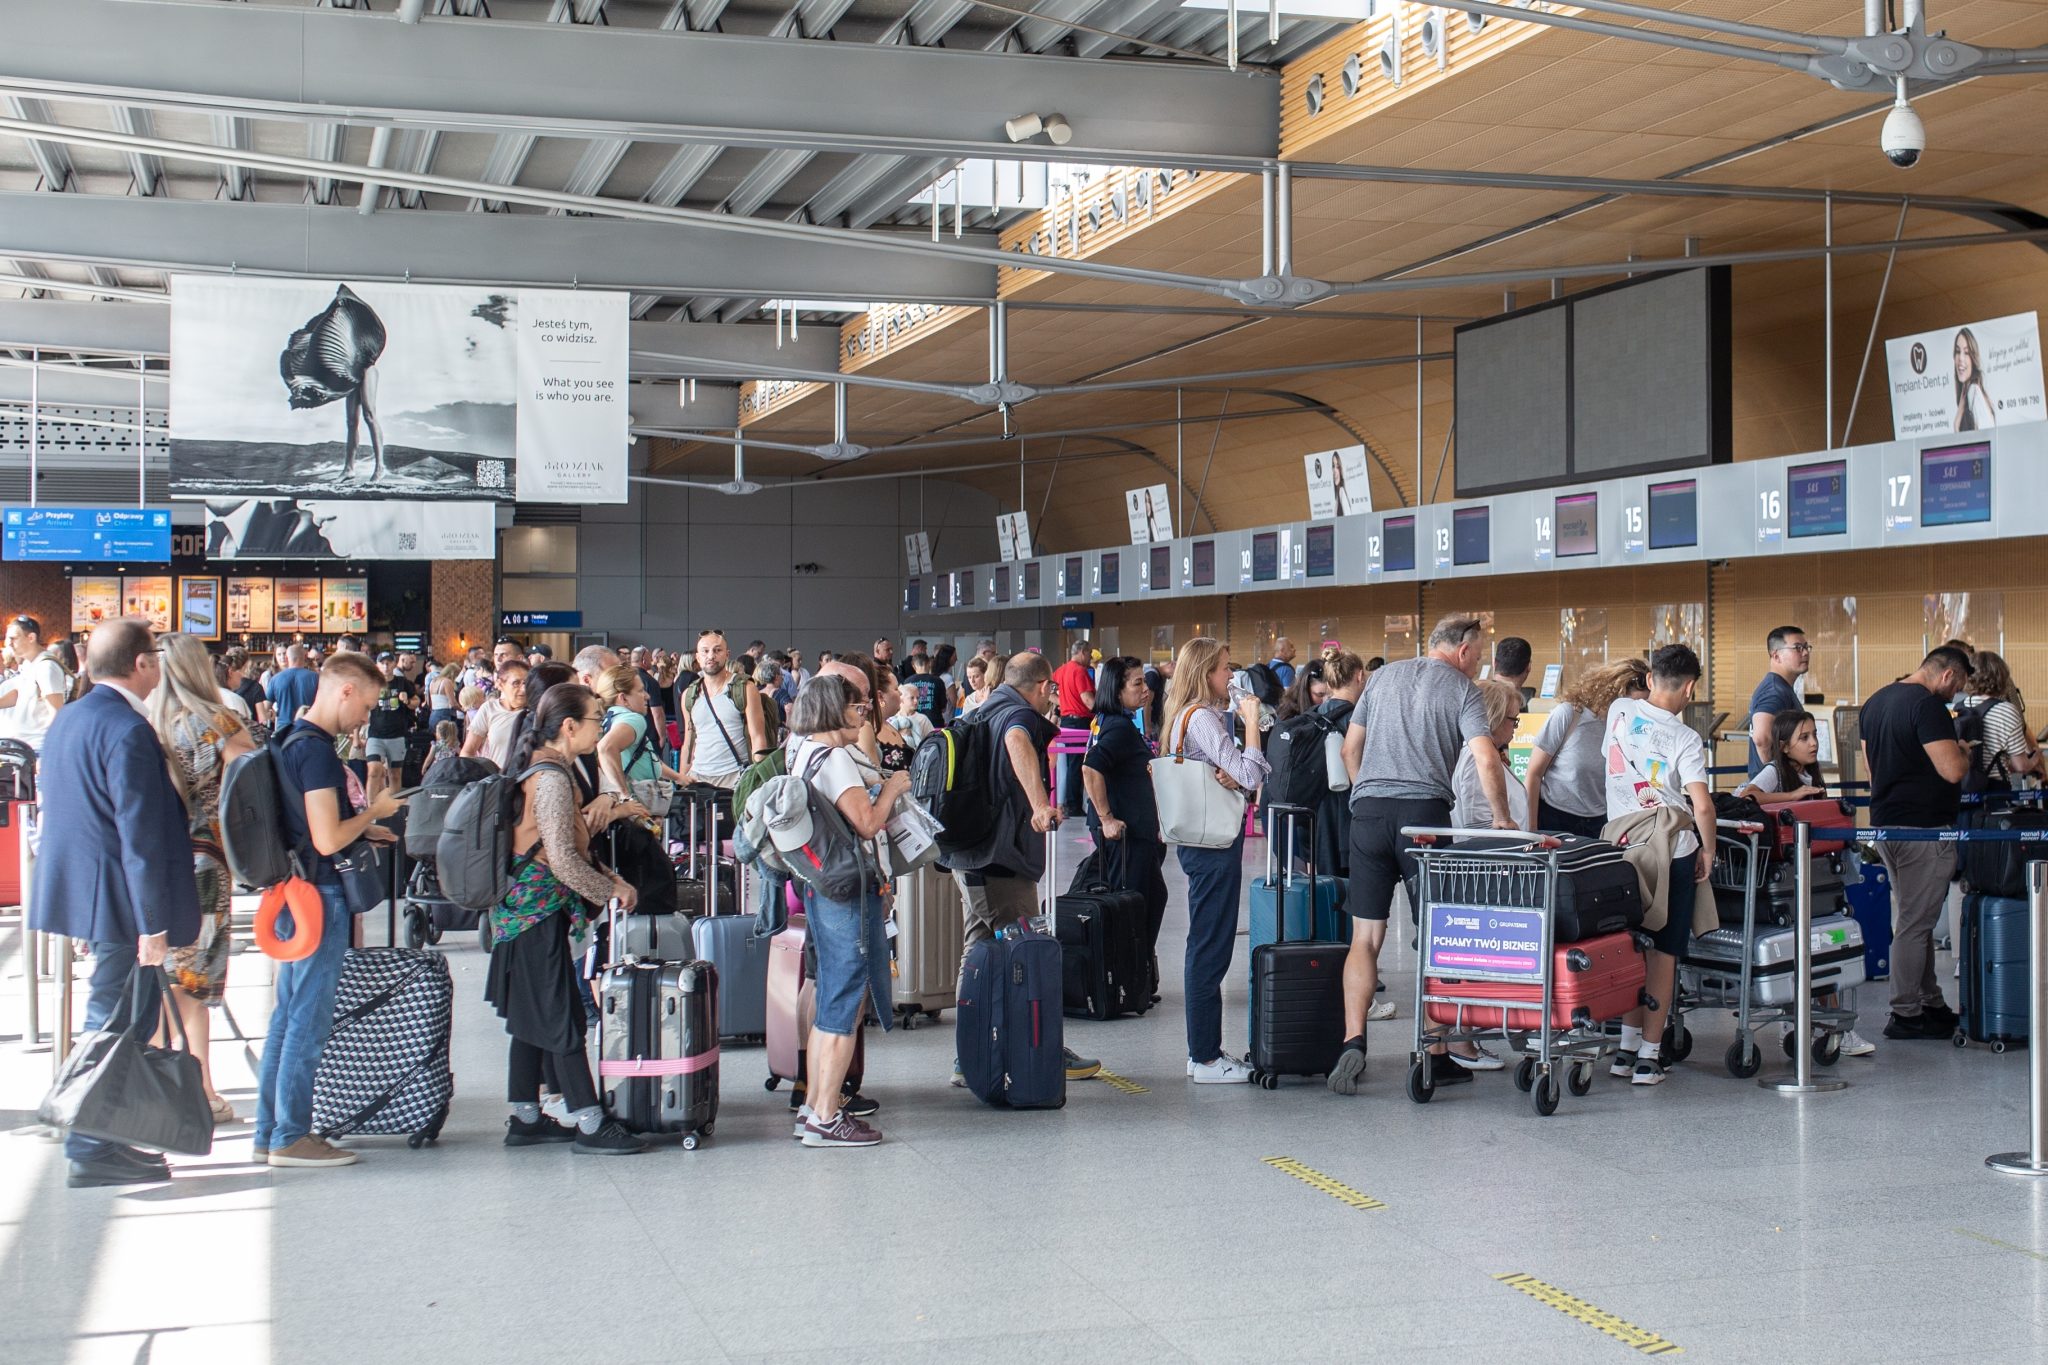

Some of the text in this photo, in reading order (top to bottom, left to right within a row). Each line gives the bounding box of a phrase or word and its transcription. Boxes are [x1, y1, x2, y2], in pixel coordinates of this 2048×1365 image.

[532, 319, 593, 331] Jesteś tym,
[541, 333, 597, 344] co widzisz.
[543, 377, 614, 389] What you see
[535, 391, 544, 400] is
[546, 391, 569, 401] who
[572, 394, 591, 403] you
[1942, 464, 1958, 479] SAS
[1888, 475, 1911, 507] 17
[1760, 490, 1780, 519] 16
[45, 512, 74, 520] Przyloty
[113, 512, 144, 521] Odprawy
[1625, 506, 1642, 533] 15
[1535, 517, 1550, 541] 14
[171, 534, 205, 556] COF
[1368, 536, 1380, 557] 12
[1436, 528, 1449, 551] 13
[1241, 550, 1251, 569] 10
[1293, 544, 1302, 563] 11
[1141, 562, 1147, 578] 8
[1183, 557, 1190, 575] 9
[1018, 575, 1023, 590] 5
[1058, 571, 1064, 586] 6
[1093, 567, 1099, 583] 7
[932, 586, 937, 599] 2
[956, 582, 961, 595] 3
[989, 578, 994, 593] 4
[904, 590, 908, 602] 1
[1433, 936, 1539, 951] PCHAMY TWÓJ BIZNES!
[387, 1065, 425, 1097] WITTCHEN
